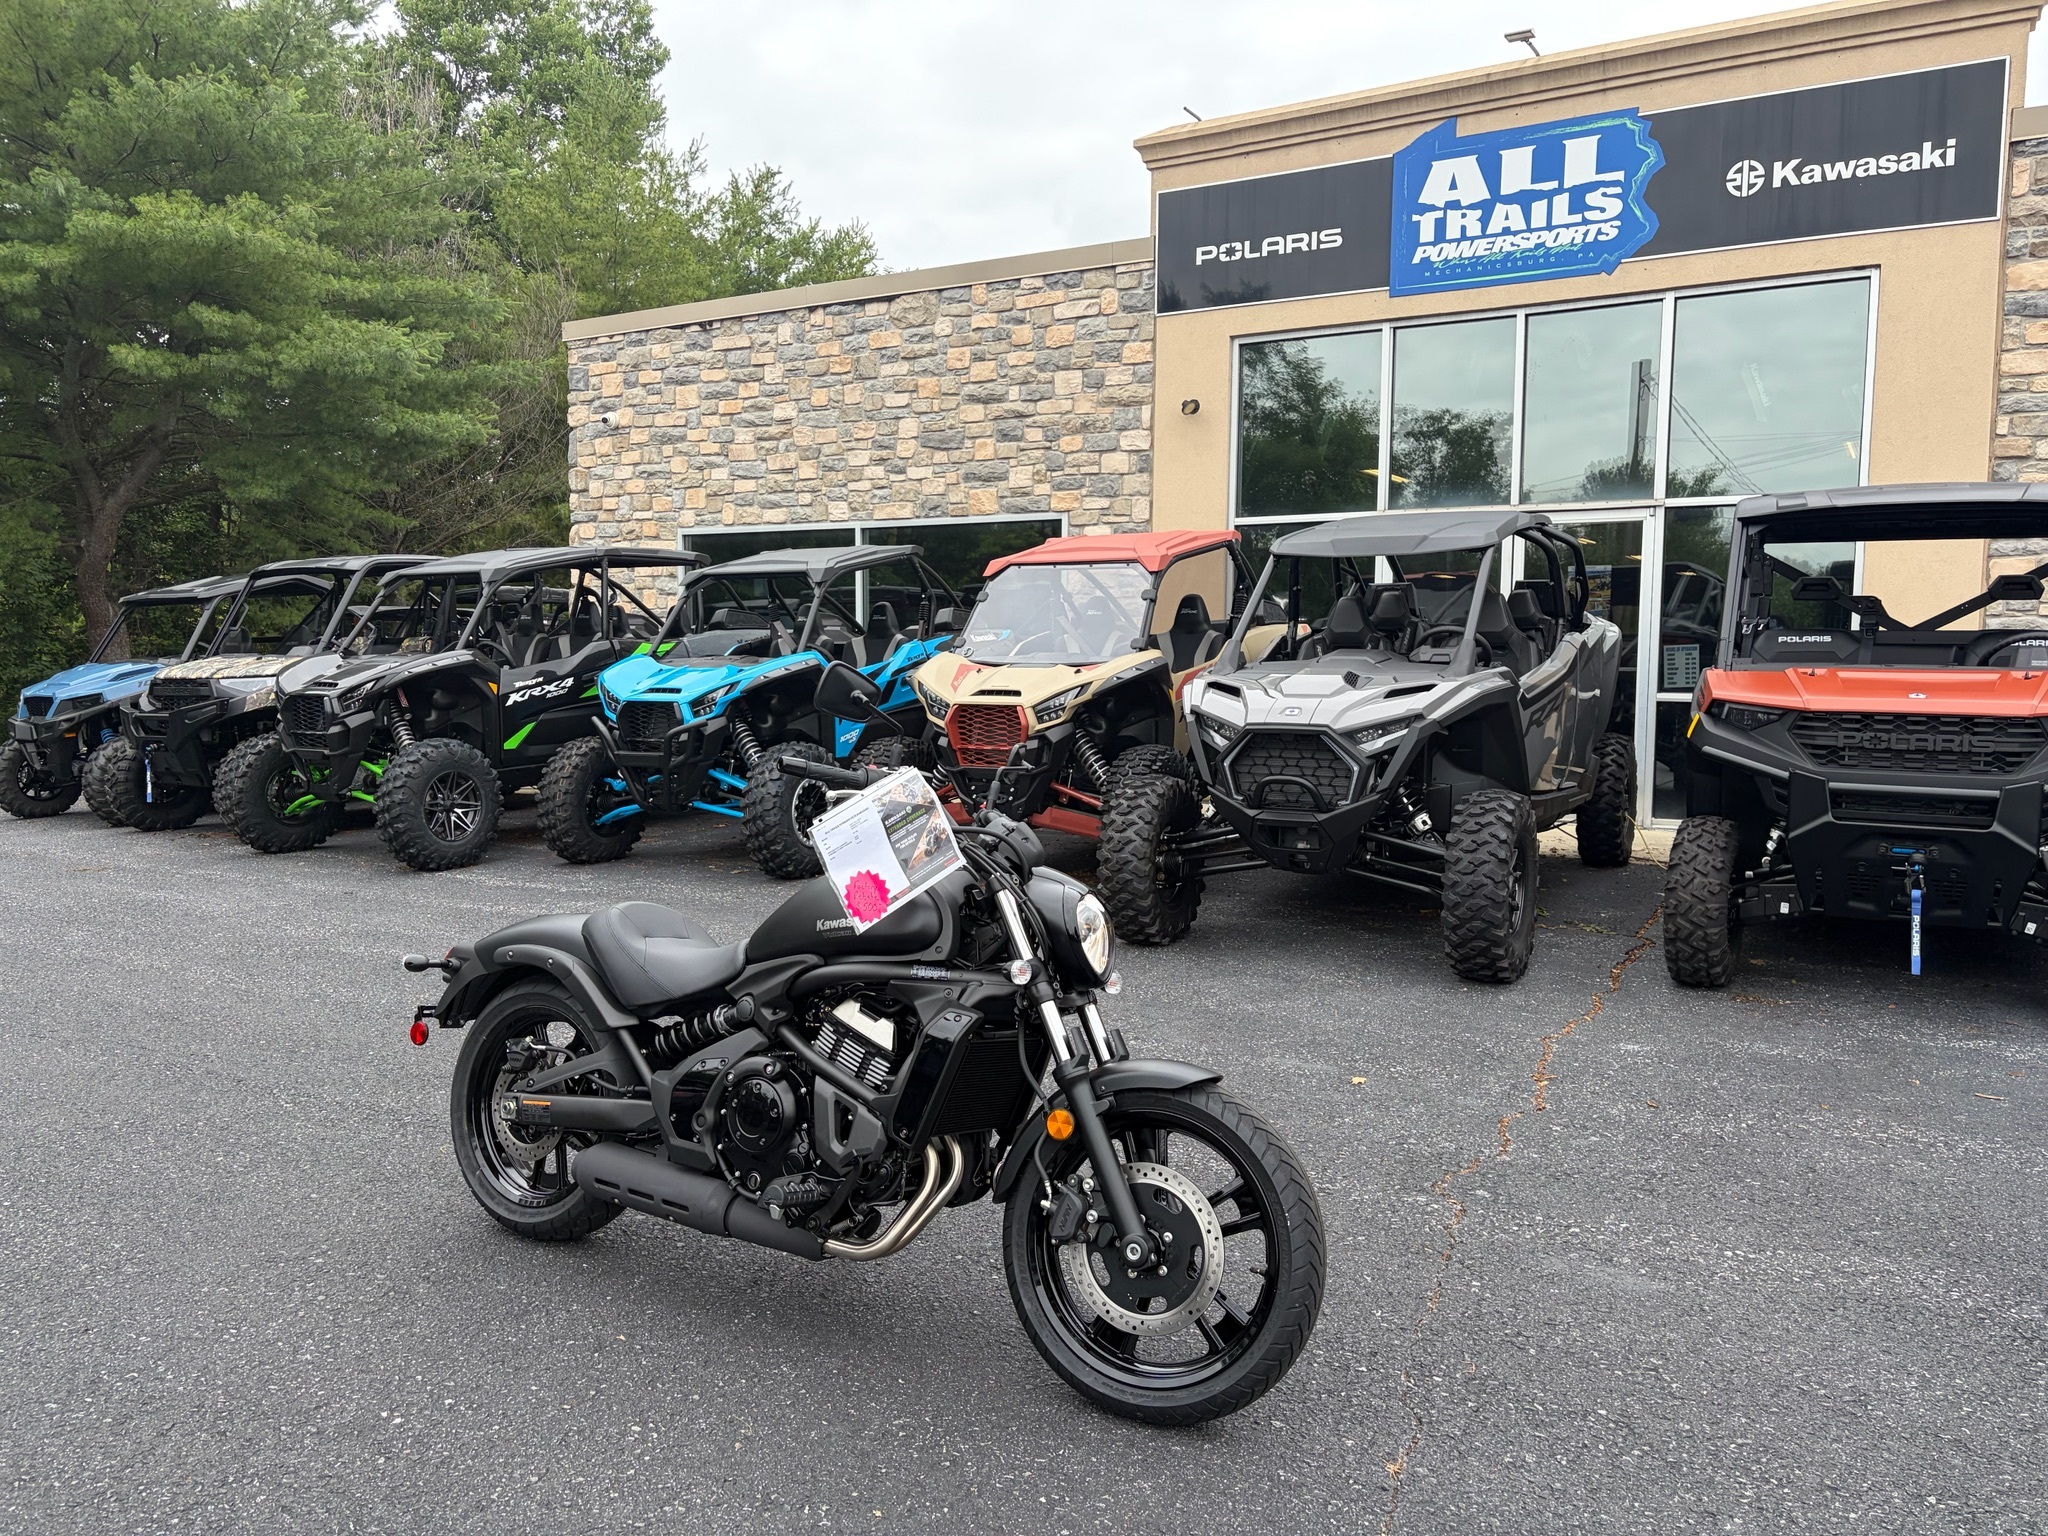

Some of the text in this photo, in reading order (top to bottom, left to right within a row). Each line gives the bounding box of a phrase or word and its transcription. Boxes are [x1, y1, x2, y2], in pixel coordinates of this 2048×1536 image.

[1418, 135, 1625, 208] ALL
[1772, 138, 1957, 188] Kawasaki
[1412, 186, 1624, 243] TRAILS
[1196, 228, 1343, 266] POLARIS
[1411, 221, 1622, 264] POWERSPORTS
[1577, 251, 1595, 259] PA
[1778, 635, 1832, 643] POLARIS
[505, 677, 574, 706] KRX4
[1837, 731, 1996, 753] POLARIS
[816, 918, 854, 931] Kawas
[1912, 914, 1920, 957] POLARIS
